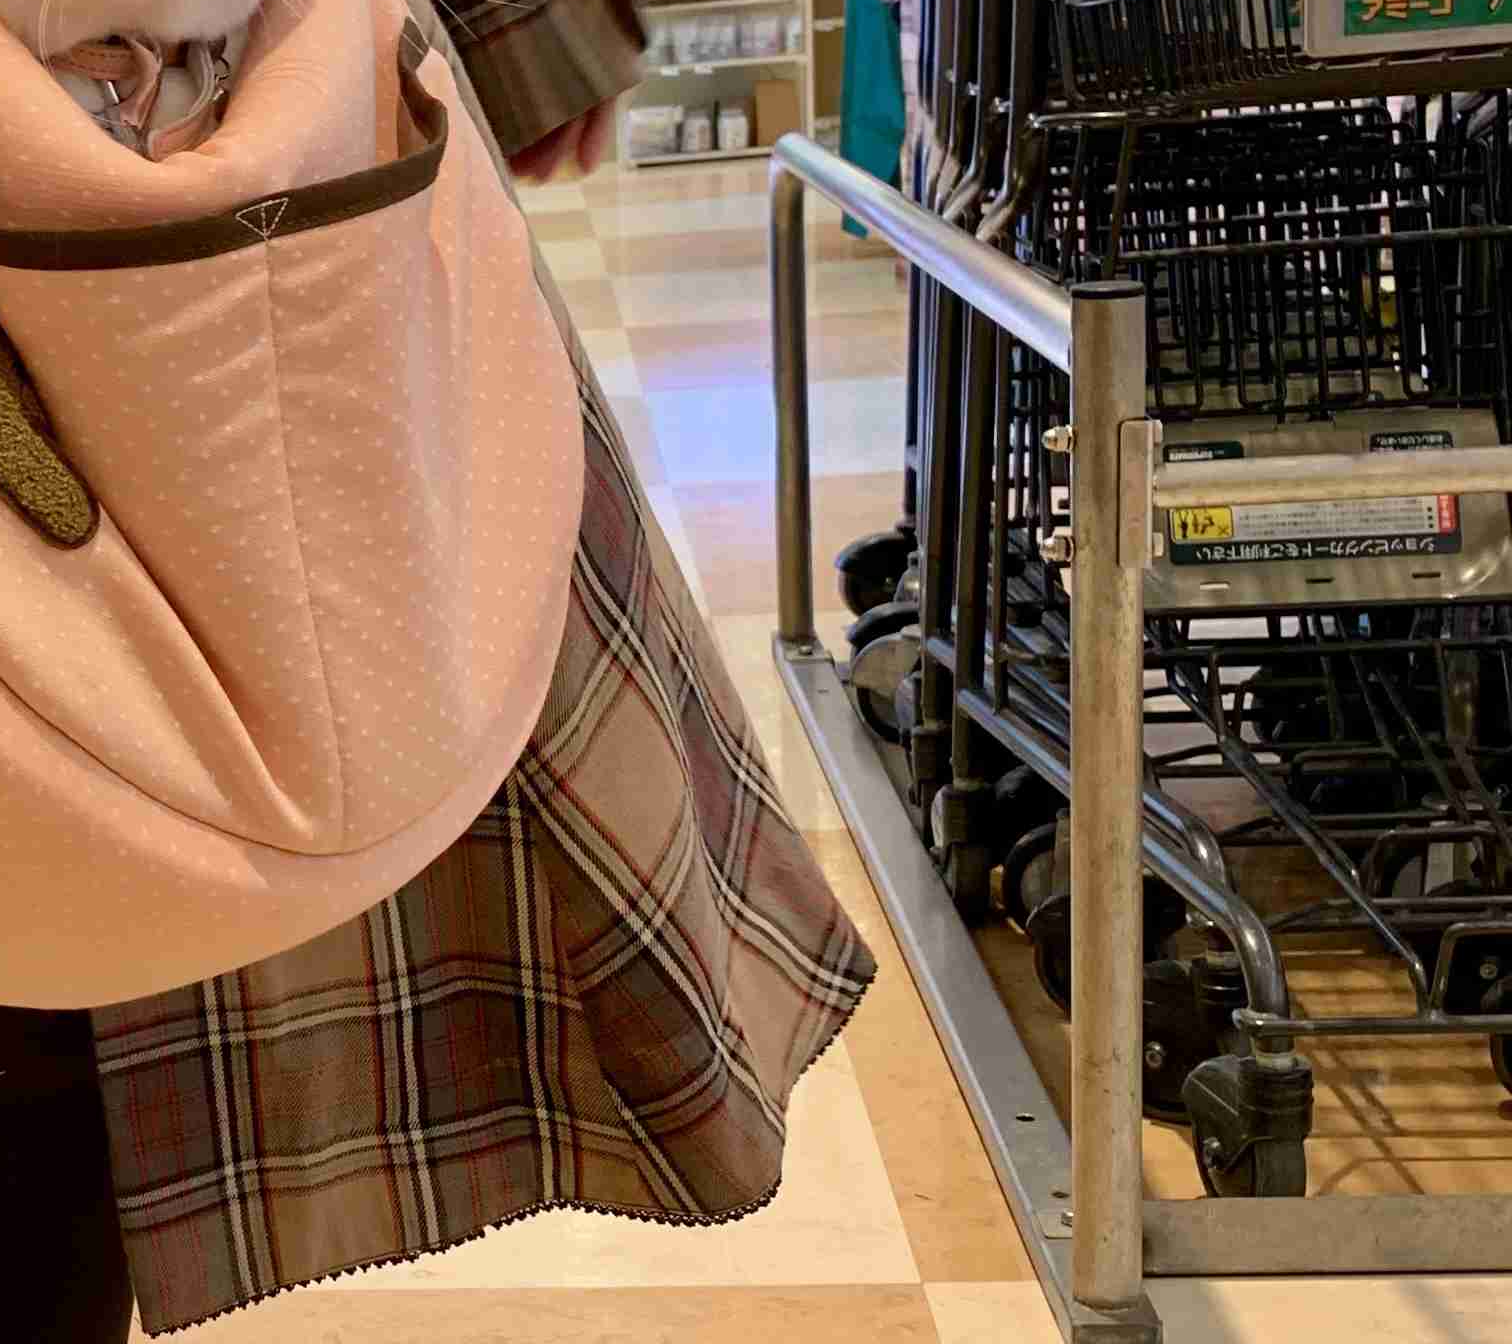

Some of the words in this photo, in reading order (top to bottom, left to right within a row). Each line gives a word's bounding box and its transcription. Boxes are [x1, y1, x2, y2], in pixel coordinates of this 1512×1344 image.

[1194, 536, 1437, 563] ショッピングカートをご利用下さい
